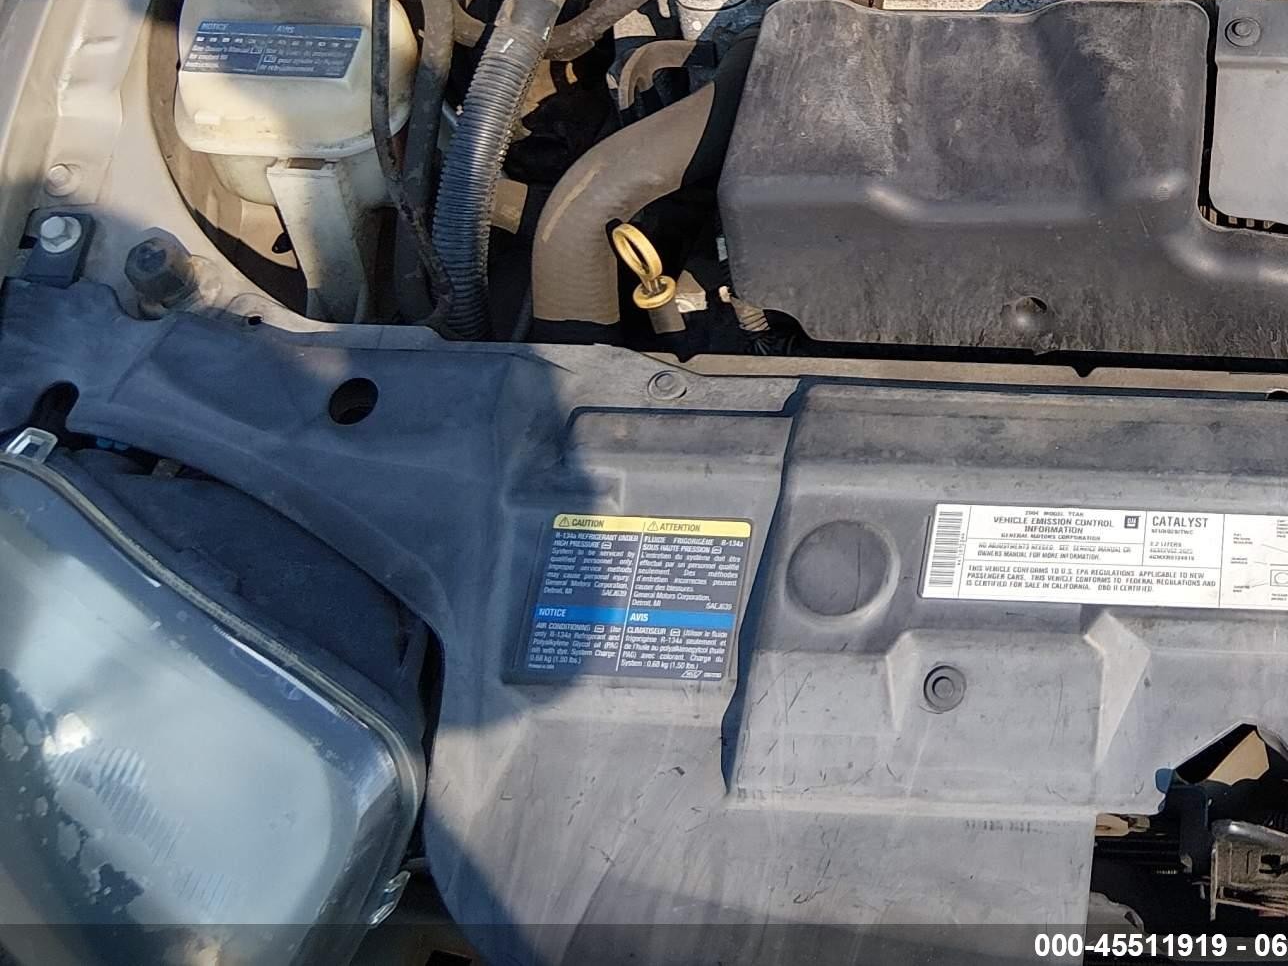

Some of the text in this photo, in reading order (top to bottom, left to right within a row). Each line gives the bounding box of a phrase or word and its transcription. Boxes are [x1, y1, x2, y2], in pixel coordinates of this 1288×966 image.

[572, 519, 604, 528] CAUTION
[993, 516, 1113, 527] VEHICLE EMISSION CONTROL
[1151, 515, 1208, 527] CATALYST
[660, 523, 701, 532] ATTENTION
[1023, 525, 1083, 534] INFORMATION
[538, 607, 566, 617] NOTICE
[629, 612, 649, 621] AVIS
